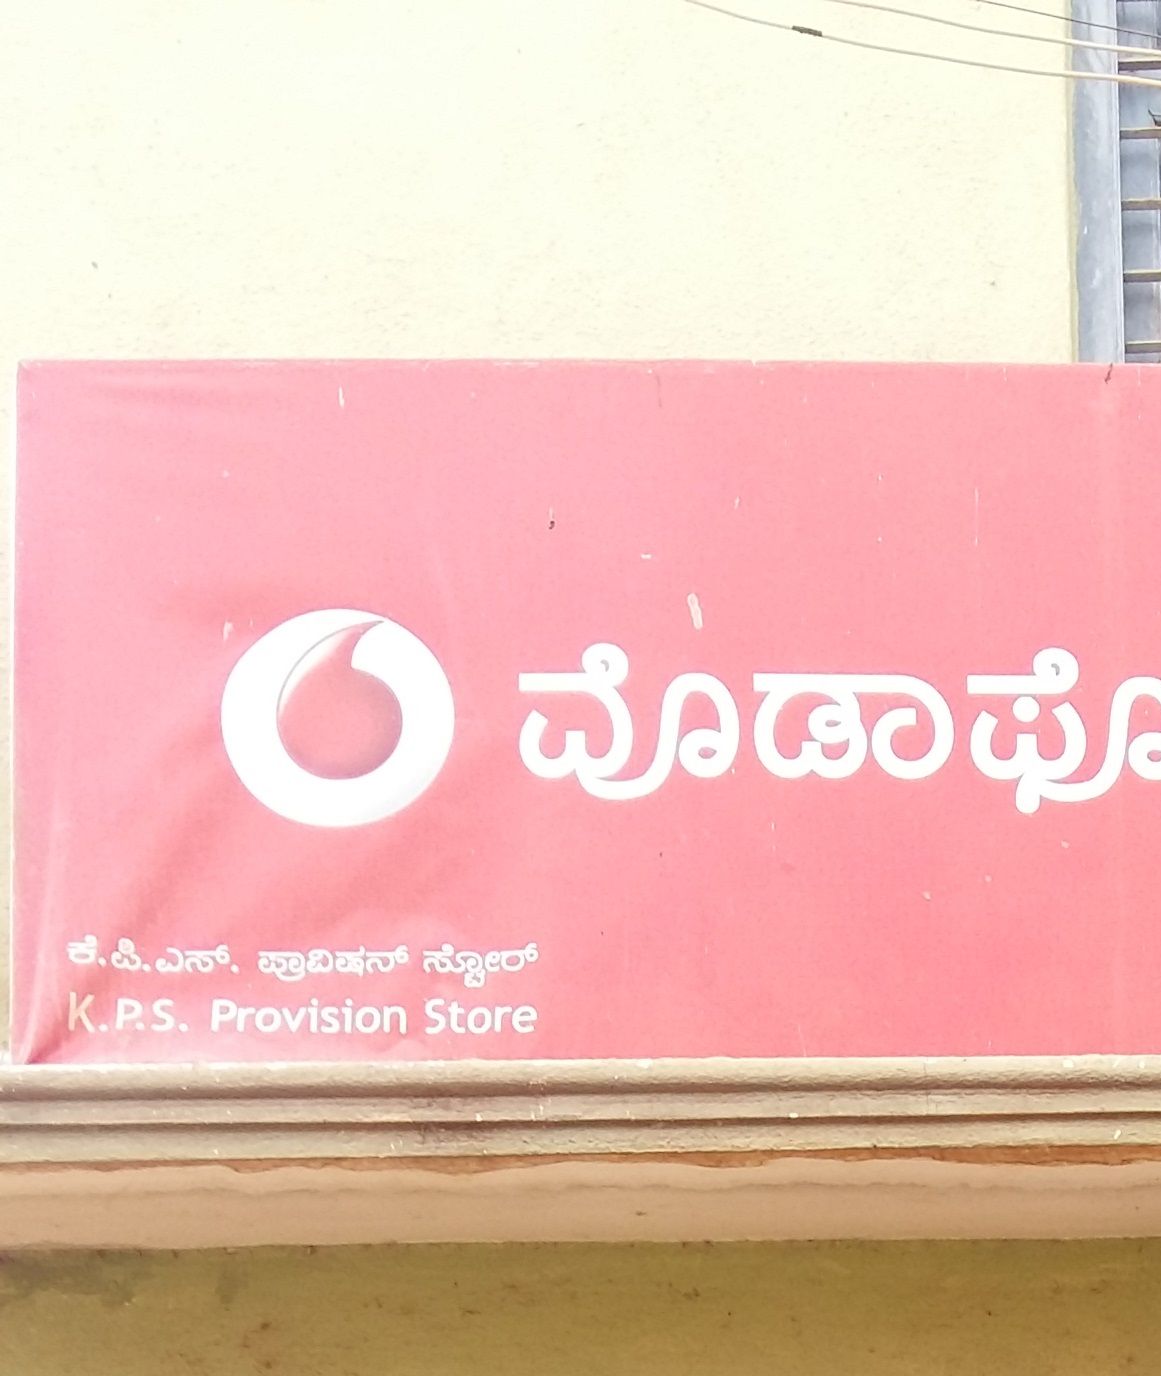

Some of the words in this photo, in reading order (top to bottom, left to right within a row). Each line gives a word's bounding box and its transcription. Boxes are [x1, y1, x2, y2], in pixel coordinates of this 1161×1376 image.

[422, 942, 539, 988] ಸ್ಟೋರ್
[67, 991, 190, 1033] K.P.S.
[210, 997, 408, 1034] Provision
[424, 998, 539, 1034] Store
